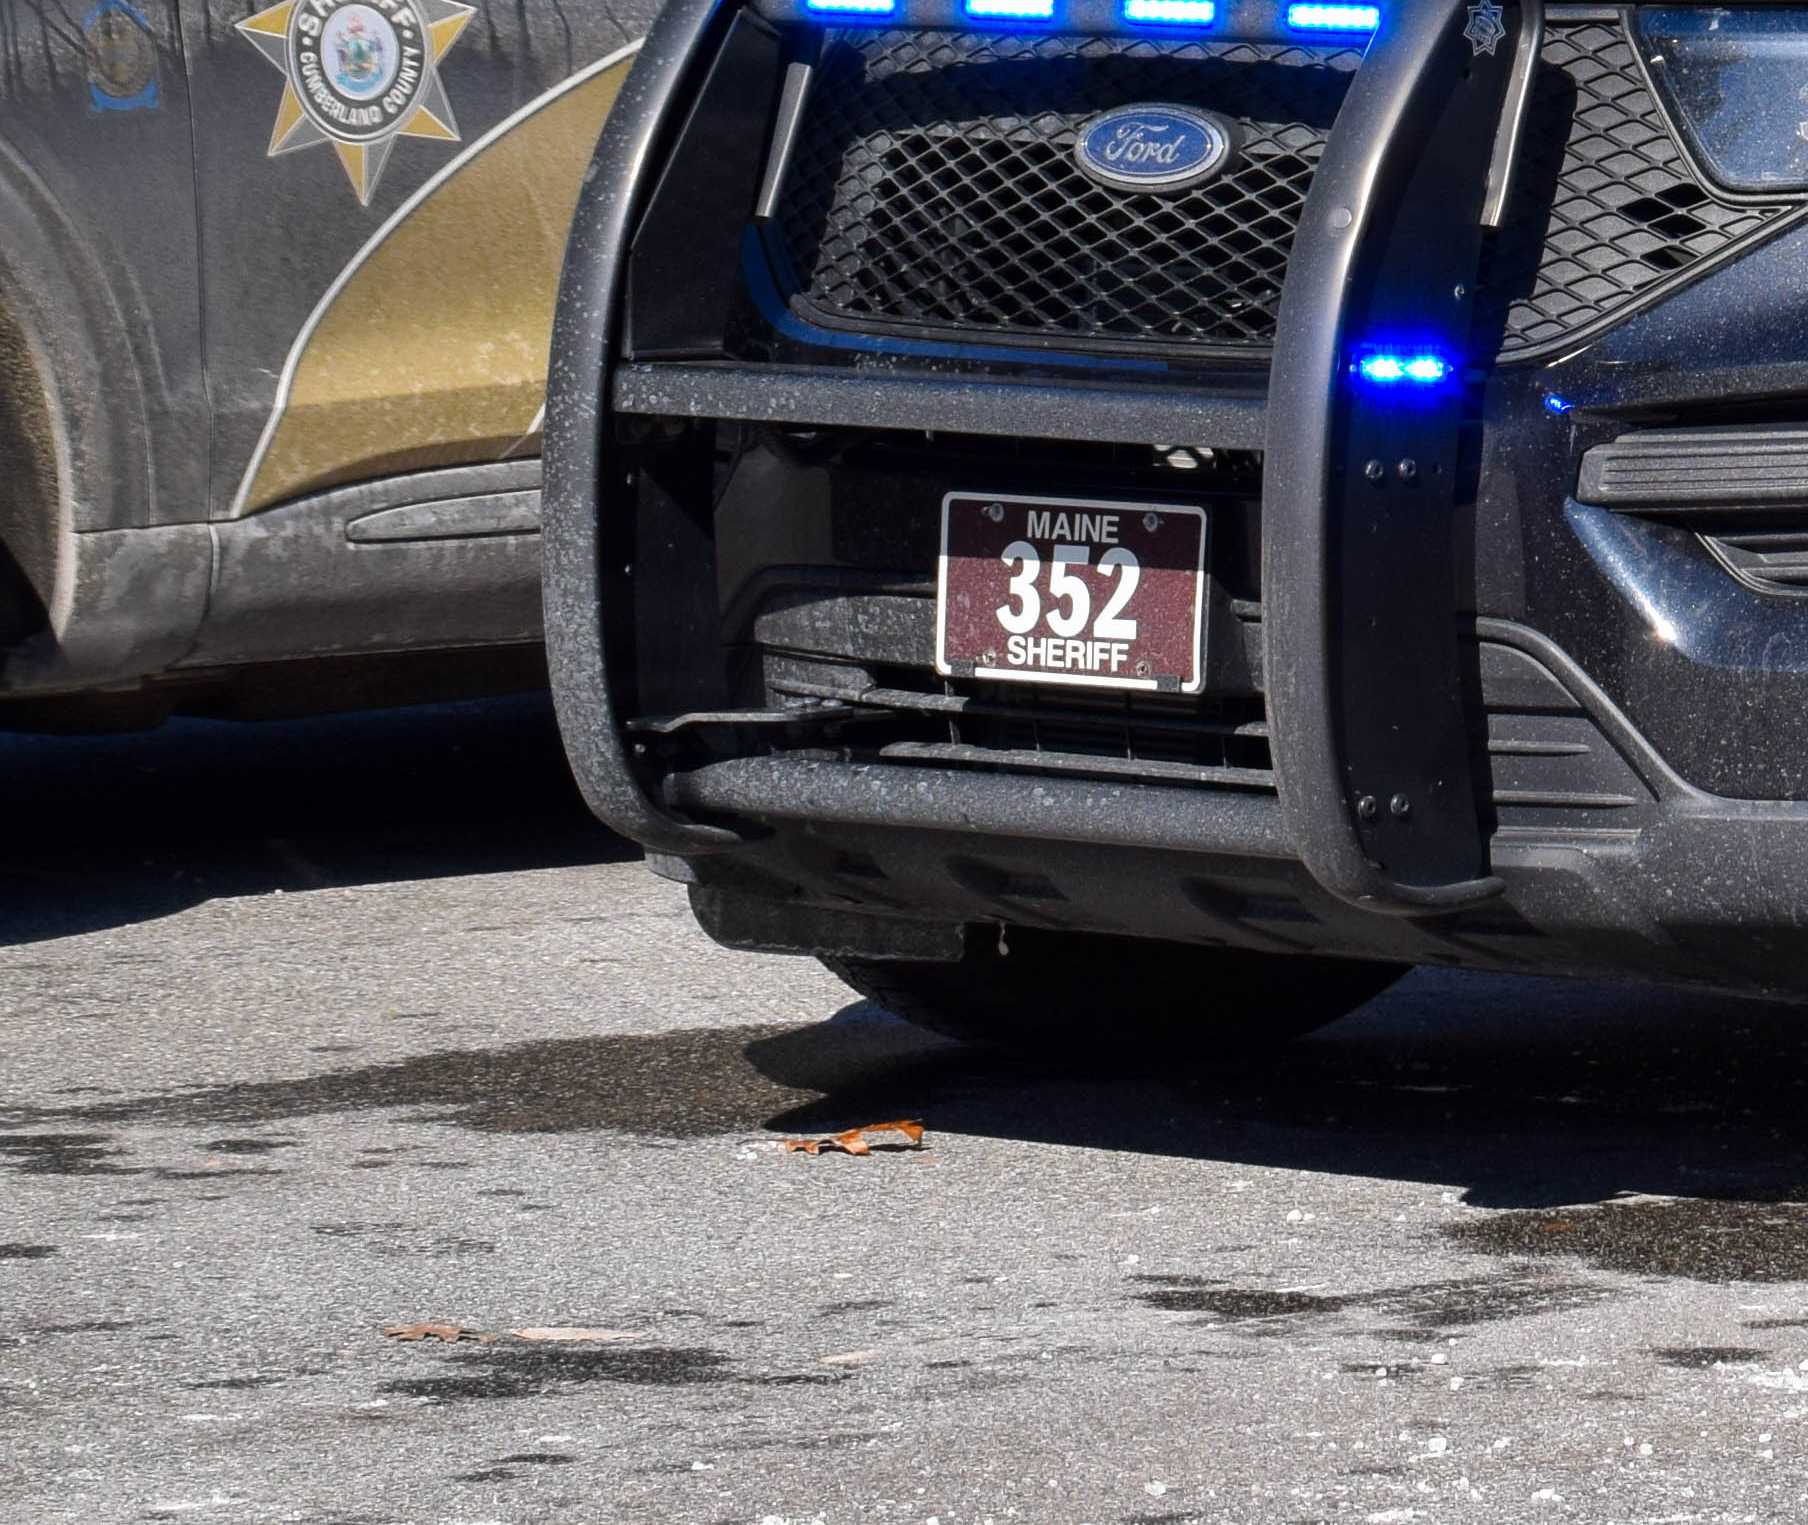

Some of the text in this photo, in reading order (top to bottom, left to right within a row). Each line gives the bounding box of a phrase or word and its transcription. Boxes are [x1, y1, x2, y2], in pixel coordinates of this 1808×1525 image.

[300, 46, 421, 126] CUMBERLAND COUNTY
[1105, 121, 1187, 165] Ford
[1027, 510, 1120, 544] MAINE
[995, 541, 1140, 640] 352
[1007, 635, 1129, 672] SHERIFF
